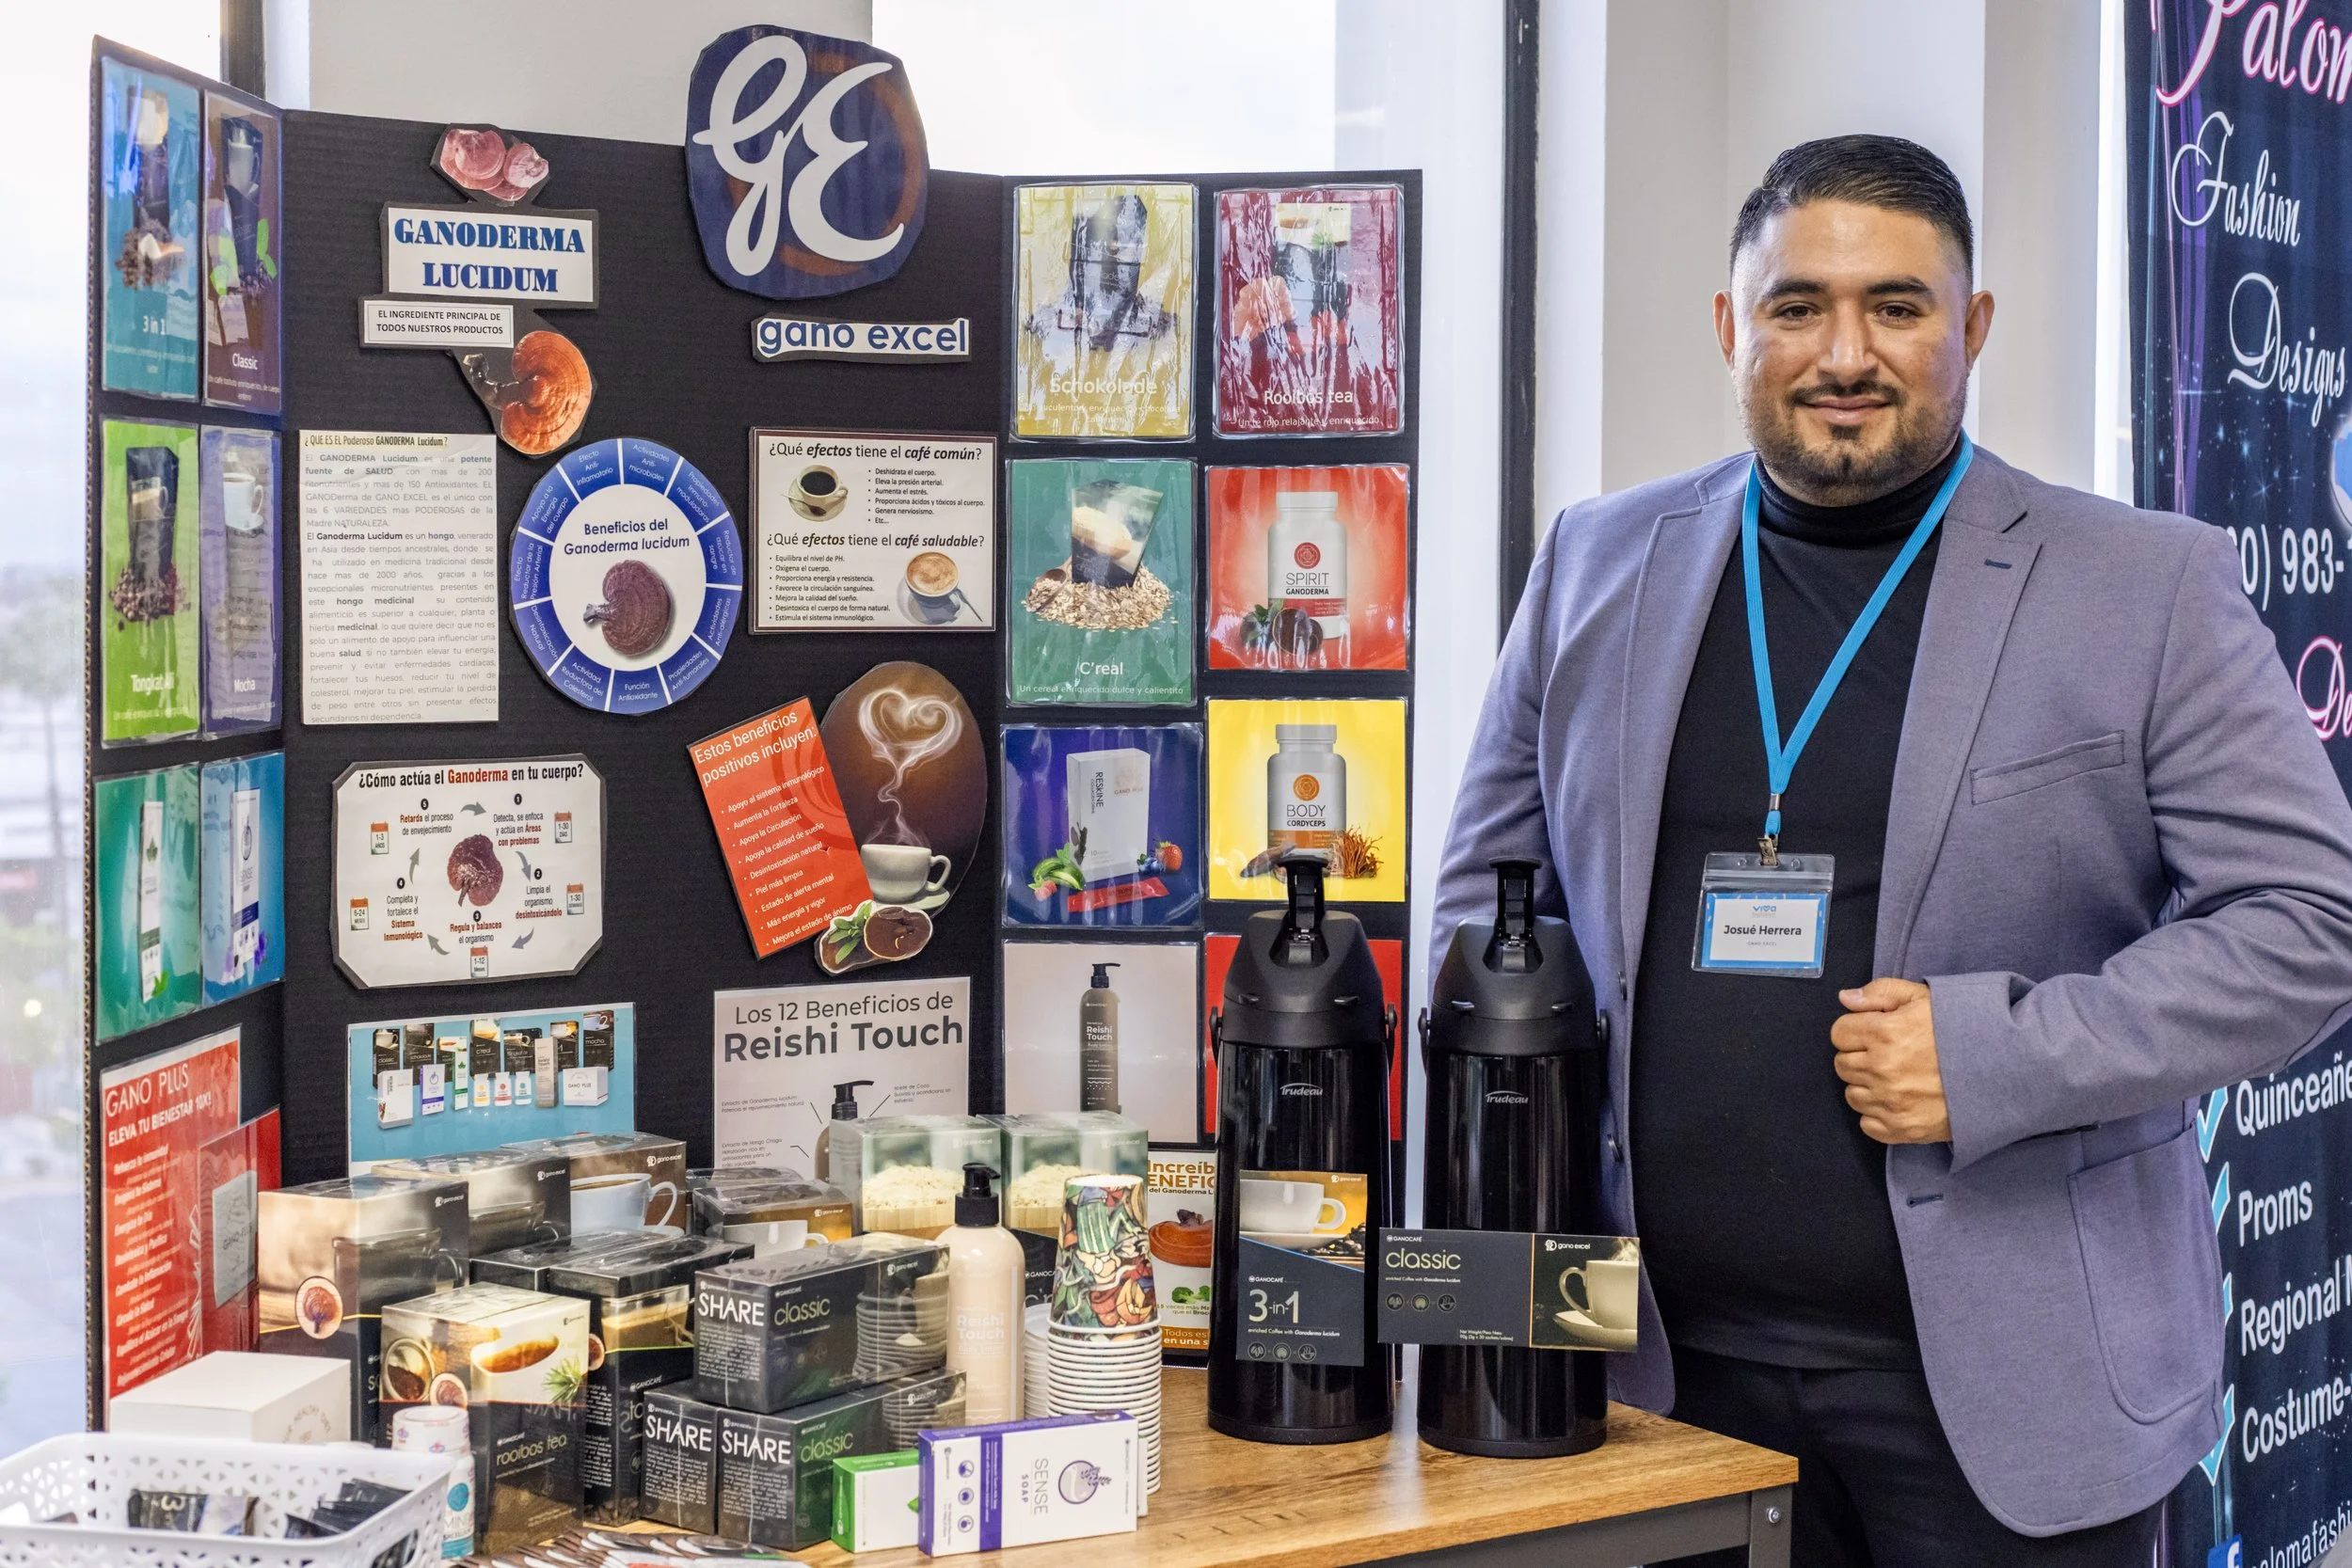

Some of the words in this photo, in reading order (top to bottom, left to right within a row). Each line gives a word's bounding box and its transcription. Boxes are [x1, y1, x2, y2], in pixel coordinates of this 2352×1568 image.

[2171, 111, 2300, 245] Fashion
[394, 218, 585, 253] GANODERMA
[422, 262, 558, 293] LUCIDUM
[378, 310, 388, 319] EL
[389, 310, 444, 320] INGREDIENTE
[446, 311, 487, 321] PRINCIPAL
[490, 312, 501, 321] DE
[376, 324, 405, 333] TODOS
[408, 325, 451, 333] NUESTROS
[453, 325, 502, 334] PRODUCTOS
[759, 321, 855, 354] gano
[867, 320, 965, 352] excel
[2227, 271, 2345, 428] Designs
[232, 352, 258, 371] Classic
[1050, 376, 1158, 396] Schokolade
[1263, 389, 1322, 405] Rooibos
[1328, 390, 1354, 404] tea
[310, 436, 324, 446] QUE
[326, 436, 333, 445] ES
[335, 436, 342, 446] EL
[343, 436, 374, 446] Poderoso
[376, 436, 414, 446] GANODERMA
[770, 443, 803, 456] ¿Qué
[806, 443, 851, 457] efectos
[855, 445, 886, 458] tiene
[891, 446, 901, 458] el
[905, 447, 930, 460] café
[934, 448, 981, 460] común?
[584, 521, 645, 535] Beneficios
[649, 518, 668, 531] del
[564, 541, 639, 555] Ganoderma
[642, 536, 690, 549] lucidum
[768, 533, 799, 546] ¿Qué
[803, 533, 845, 547] efectos
[849, 534, 878, 546] tiene
[882, 534, 892, 546] el
[895, 534, 919, 548] café
[922, 534, 984, 547] saludable?
[1286, 572, 1329, 585] SPIRIT
[2227, 524, 2271, 611] 0)
[2281, 528, 2352, 594] 983-
[234, 678, 256, 693] Mocha
[618, 691, 659, 702] Antioxidante
[625, 681, 650, 690] Función
[1020, 685, 1030, 693] Un
[1033, 685, 1058, 693] cereal
[1061, 685, 1110, 696] enriquecido
[1112, 685, 1134, 693] dulce
[1136, 687, 1142, 696] y
[1144, 685, 1184, 694] calientito
[694, 739, 732, 765] Estos
[733, 710, 798, 749] beneficios
[702, 748, 760, 787] positivos
[761, 724, 817, 760] incluyen:
[359, 772, 396, 788] ¿Cómo
[400, 769, 431, 786] actúa
[435, 770, 444, 784] el
[448, 768, 508, 784] Ganoderma
[512, 768, 524, 781] en
[528, 766, 538, 780] tu
[542, 764, 583, 782] cuerpo?
[728, 799, 749, 814] Apoyo
[749, 796, 755, 805] al
[756, 784, 782, 800] sistema
[782, 765, 825, 790] inmunológico
[400, 814, 423, 823] Retarda
[424, 814, 430, 822] el
[431, 813, 453, 823] proceso
[1286, 804, 1327, 817] BODY
[391, 919, 415, 928] Sistema
[1724, 925, 1756, 935] Josué
[1759, 926, 1802, 935] Herrera
[384, 931, 423, 942] Inmunológico
[736, 1006, 771, 1024] Los
[778, 1003, 798, 1022] 12
[806, 994, 920, 1020] Beneficios
[927, 991, 953, 1010] de
[724, 1022, 838, 1063] Reishi
[850, 1015, 962, 1051] Touch
[106, 1078, 151, 1117] GANO
[158, 1063, 188, 1098] PLUS
[1280, 1083, 1323, 1097] Trudeau
[1485, 1090, 1528, 1105] Trudeau
[108, 1128, 136, 1148] ELEVA
[137, 1117, 151, 1134] TU
[151, 1099, 194, 1131] BIENESTAR
[2239, 1180, 2313, 1248] Proms
[1386, 1247, 1461, 1270] classic
[698, 1292, 765, 1327] SHARE
[774, 1295, 831, 1325] classic
[1249, 1289, 1298, 1323] 3-in-1
[2241, 1258, 2341, 1356] Regional
[957, 1314, 1004, 1327] Reishi
[957, 1327, 1004, 1340] Touch
[1165, 1329, 1193, 1338] Todos
[644, 1415, 712, 1452] SHARE
[497, 1441, 544, 1466] rooibos
[547, 1434, 567, 1449] tea
[721, 1429, 791, 1465] SHARE
[801, 1431, 853, 1464] classic
[1021, 1474, 1029, 1503] SOAP
[1033, 1458, 1049, 1514] SENSE
